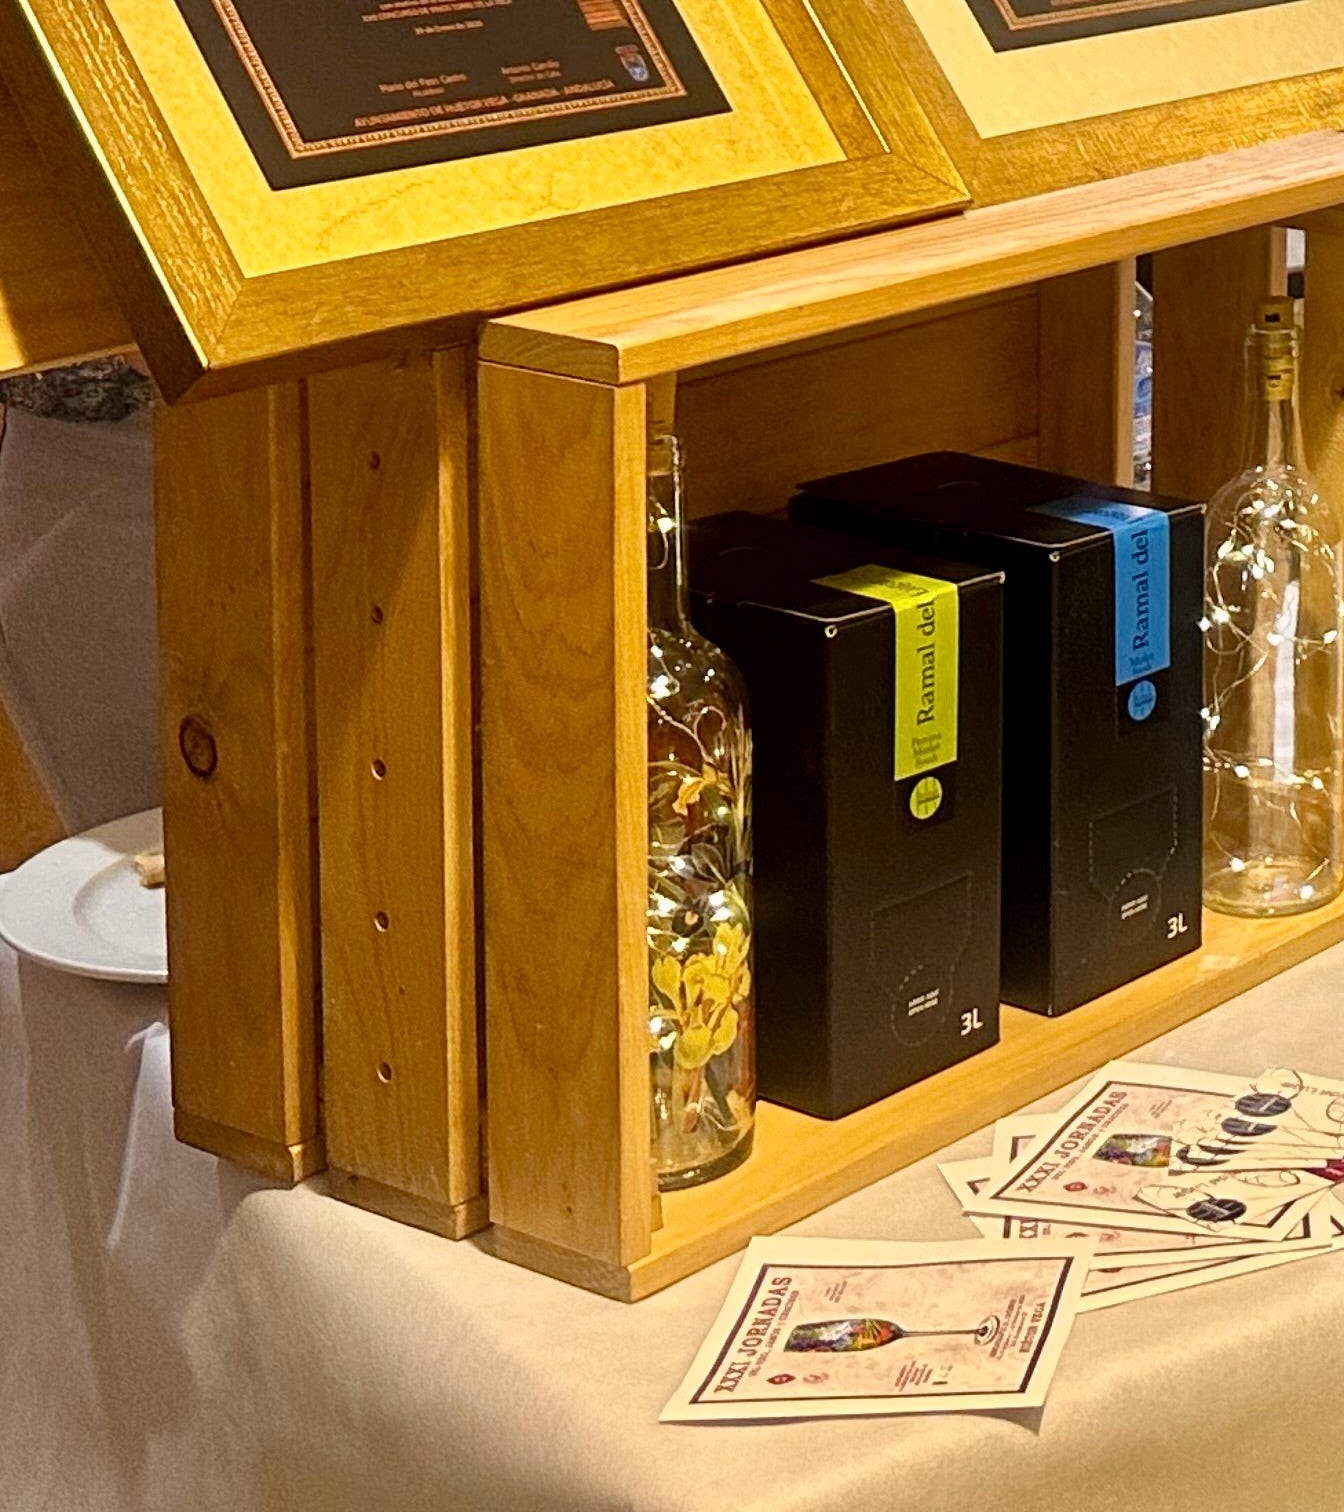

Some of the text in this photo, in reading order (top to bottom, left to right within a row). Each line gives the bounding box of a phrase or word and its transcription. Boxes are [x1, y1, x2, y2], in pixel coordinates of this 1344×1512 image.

[915, 599, 936, 637] del
[1131, 529, 1150, 651] Ramal del
[915, 643, 936, 727] Ramal
[1167, 912, 1188, 939] 3L
[960, 1007, 984, 1036] 3L
[1015, 1161, 1061, 1193] XXXI
[1053, 1090, 1128, 1159] JORNADAS
[713, 1361, 750, 1393] XXXI
[738, 1276, 792, 1357] JORNADAS
